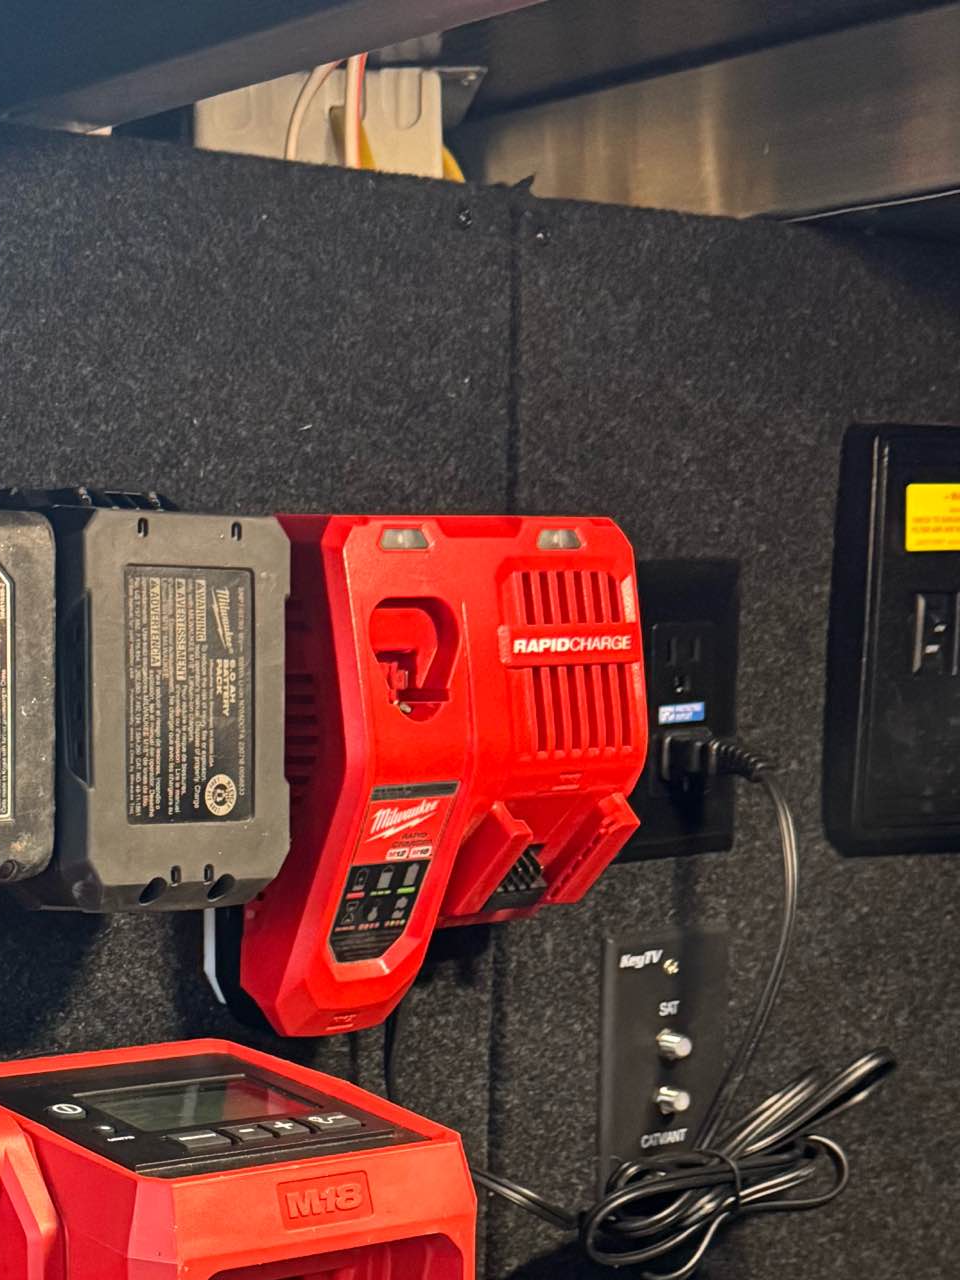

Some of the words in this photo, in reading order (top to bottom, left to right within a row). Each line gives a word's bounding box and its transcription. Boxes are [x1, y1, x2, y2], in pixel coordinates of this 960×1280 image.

[151, 592, 159, 664] ADVERTENCIA
[196, 592, 205, 641] WARNING
[216, 586, 233, 654] Milwaukee
[177, 592, 185, 678] AVERTISSEMENT
[513, 636, 631, 654] RAPIDCHARGE
[230, 685, 236, 703] AH
[193, 785, 201, 808] Charge
[369, 799, 439, 833] Milwaukee
[619, 949, 663, 969] KeyTV
[659, 1000, 680, 1016] SAT
[285, 1183, 363, 1219] M18
